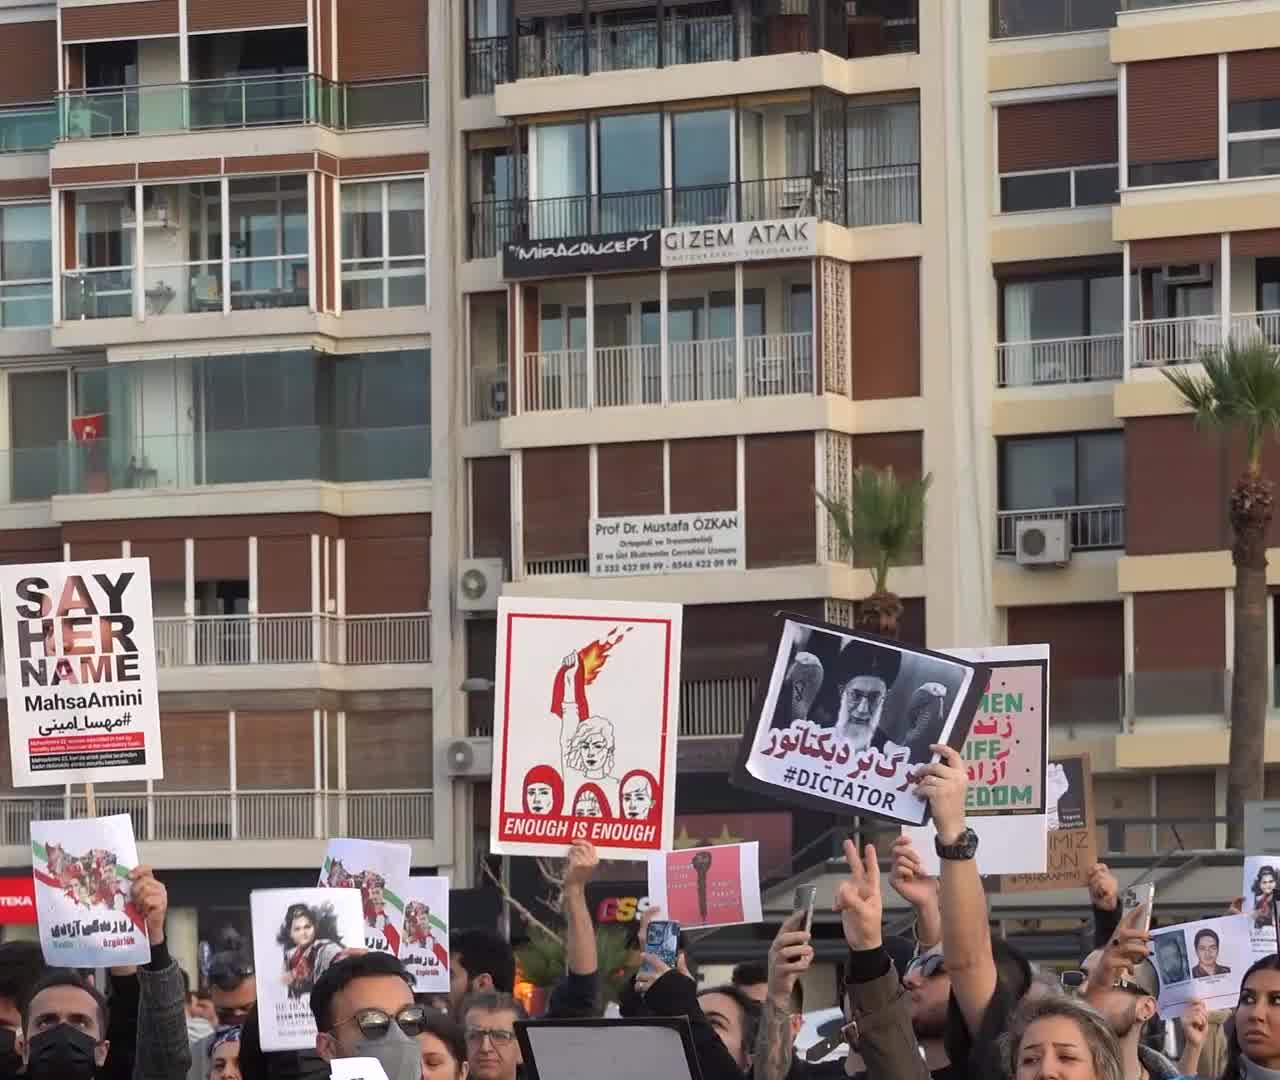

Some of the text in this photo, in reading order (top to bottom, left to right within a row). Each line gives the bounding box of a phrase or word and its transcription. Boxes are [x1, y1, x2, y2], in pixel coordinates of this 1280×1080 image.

[747, 223, 809, 243] ATAK
[623, 522, 639, 534] Dr.
[642, 520, 689, 533] Mustafa
[693, 514, 738, 530] ÖZKAN
[16, 572, 135, 619] SAY
[17, 615, 138, 658] HER
[20, 654, 140, 688] NAME
[24, 689, 142, 712] MahsaAmini
[38, 712, 132, 736] #مهسا_امینی
[760, 725, 851, 769] دیکتاتور
[783, 766, 897, 811] #DICTATOR
[504, 818, 656, 842] ENOUGH IS ENOUGH
[0, 896, 33, 907] TEKA
